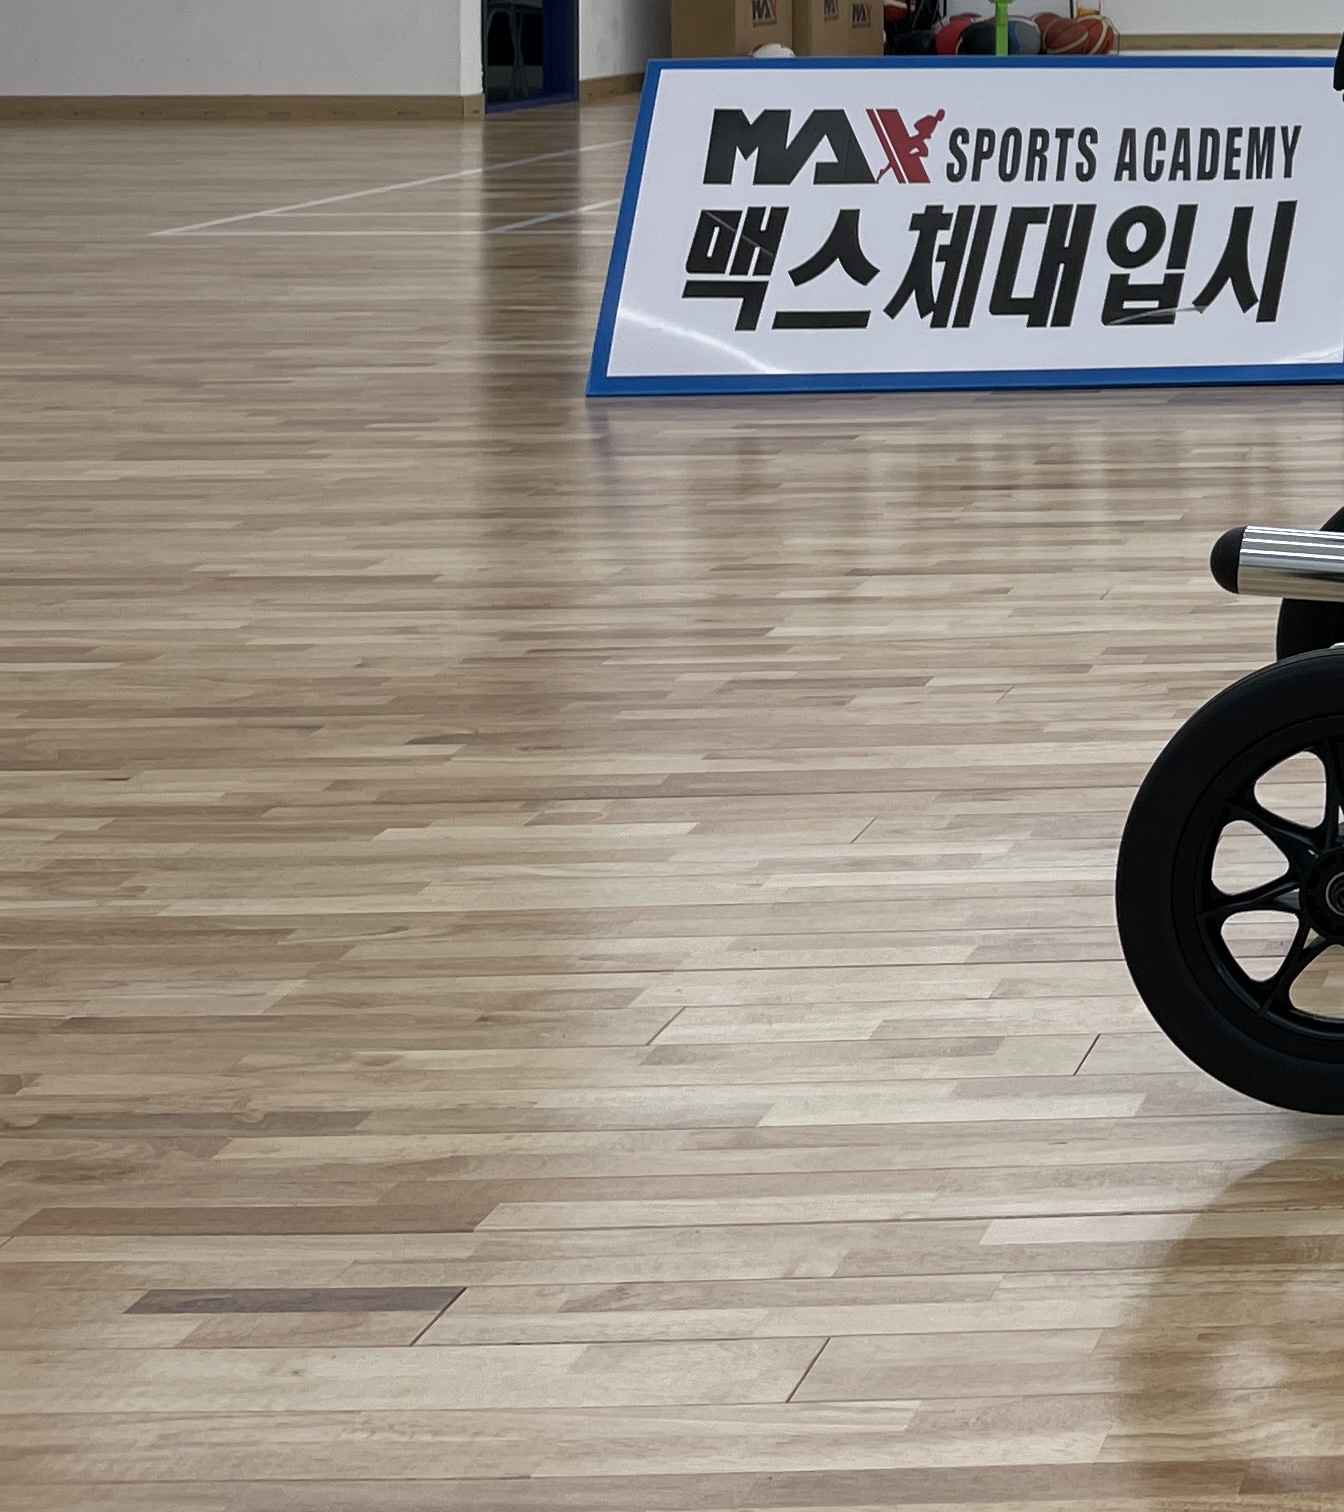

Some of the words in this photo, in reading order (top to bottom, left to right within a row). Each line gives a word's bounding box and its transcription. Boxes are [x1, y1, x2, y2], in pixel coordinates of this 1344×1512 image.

[702, 108, 945, 184] MAX
[946, 127, 1099, 183] SPORTS
[1113, 125, 1302, 182] ACADEMY
[681, 200, 1298, 332] 맥스체대입시
